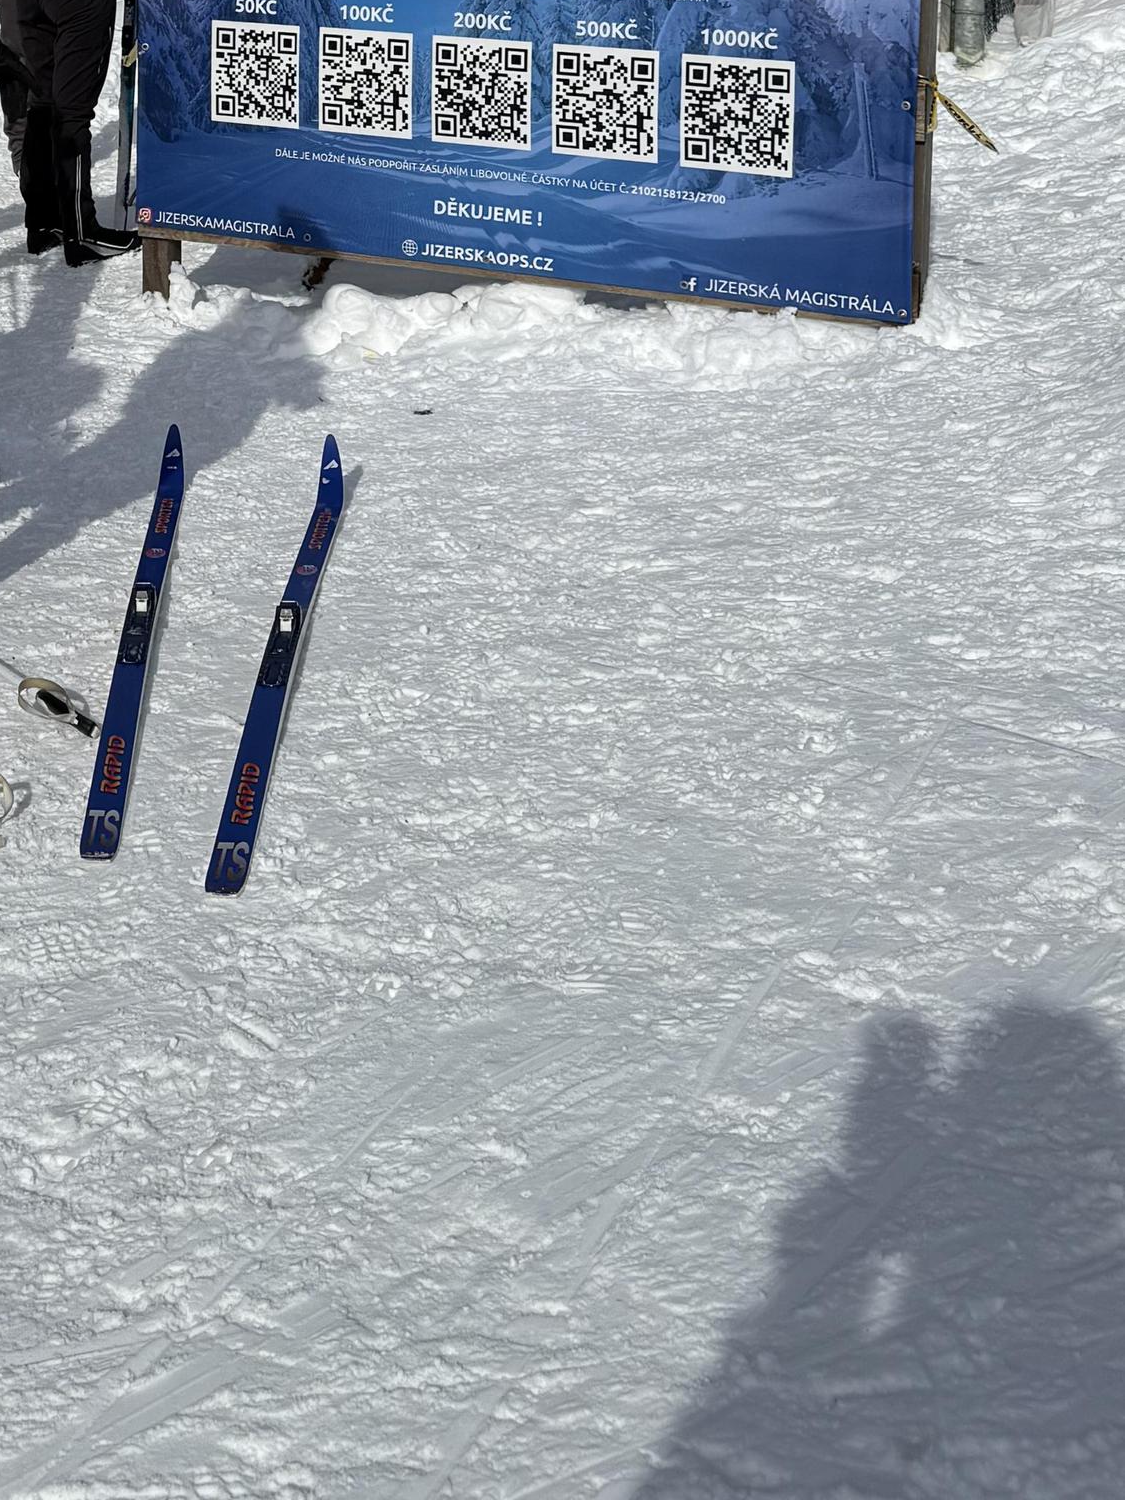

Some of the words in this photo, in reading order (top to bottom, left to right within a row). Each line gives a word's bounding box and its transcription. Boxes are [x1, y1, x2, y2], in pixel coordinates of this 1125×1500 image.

[339, 3, 394, 23] 100KČ
[453, 11, 512, 31] 200KČ
[575, 18, 639, 40] 500KČ
[700, 27, 779, 50] 1000KČ
[275, 148, 298, 159] DÁLE
[299, 152, 311, 161] JE
[312, 151, 346, 164] MOŽNÉ
[347, 155, 367, 167] NÁS
[368, 158, 417, 172] PODPOŘIT
[419, 163, 468, 177] ZASLÁNÍM
[470, 168, 527, 182] LIBOVOLNÉ
[531, 172, 571, 187] ČÁSTKY
[573, 180, 588, 189] NA
[590, 179, 616, 192] ÚČET
[619, 182, 629, 194] Č.
[631, 185, 726, 205] 2102158123/2700
[155, 211, 295, 239] JIZERSKAMAGISTRALA
[433, 197, 533, 226] DĚKUJEME
[421, 243, 554, 272] JIZERSKAOPS.CZ
[704, 278, 782, 301] JIZERSKÁ
[785, 288, 895, 315] MAGISTRÁLA
[100, 734, 126, 795] RAPID
[230, 762, 261, 826] RAPID
